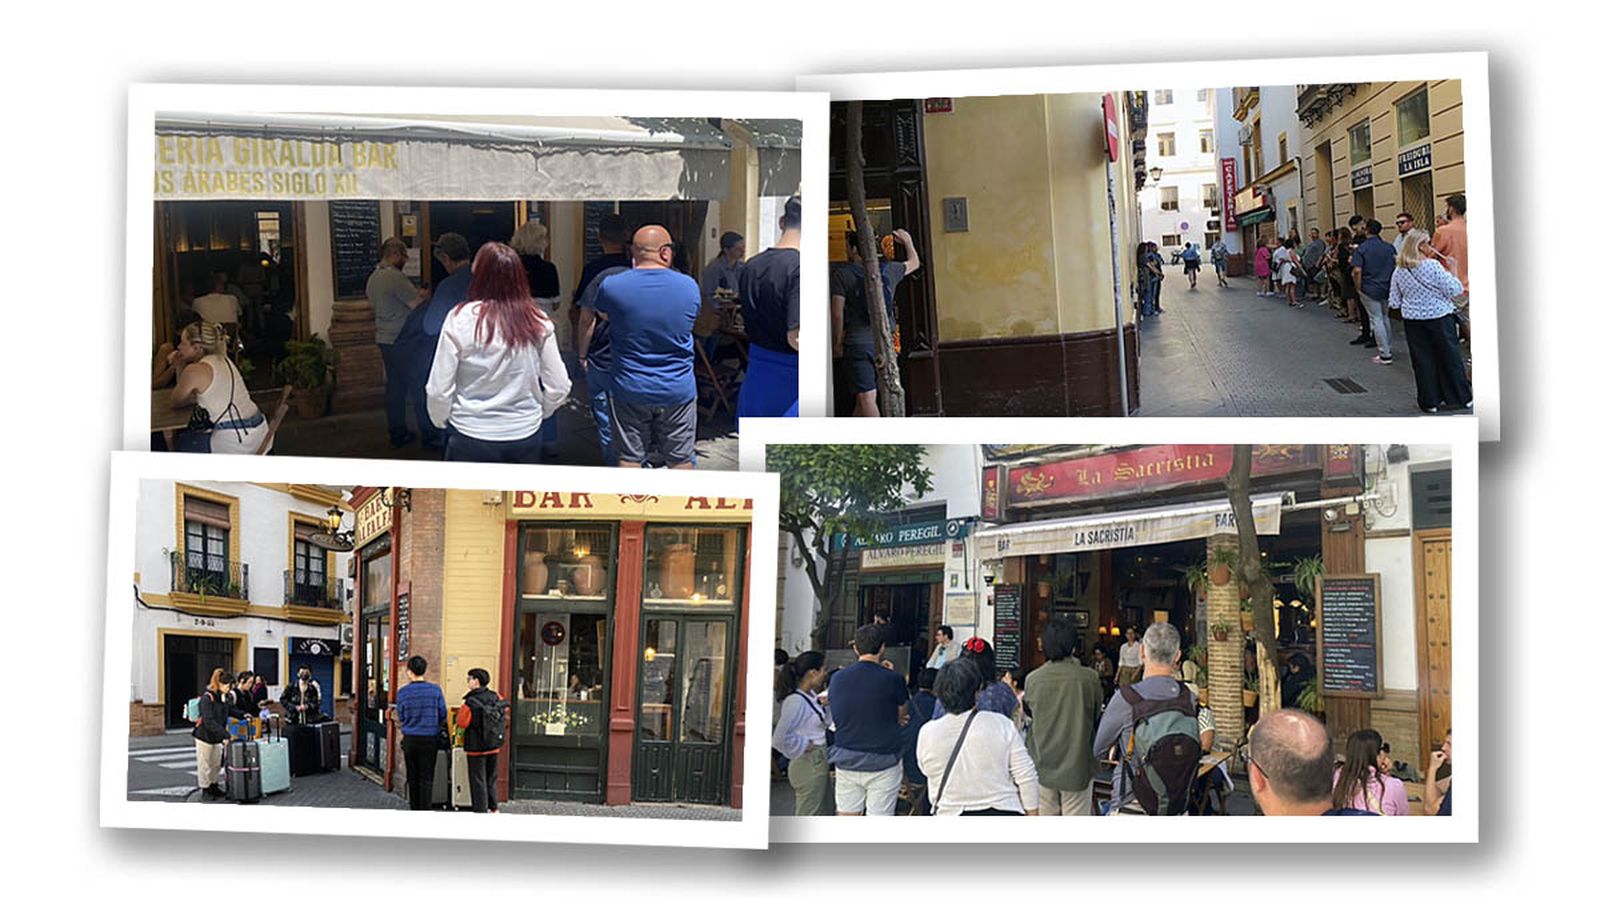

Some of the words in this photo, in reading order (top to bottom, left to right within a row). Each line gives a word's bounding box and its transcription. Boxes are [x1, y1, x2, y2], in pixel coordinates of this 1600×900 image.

[155, 136, 224, 165] ERIA
[233, 137, 343, 169] GIRALDA
[353, 142, 398, 170] BAR
[1413, 156, 1430, 170] ISLA
[273, 171, 328, 194] SIGLO
[334, 172, 358, 194] XII
[1077, 468, 1102, 486] La
[365, 497, 383, 521] BAR
[899, 526, 942, 542] PEREGIL
[1075, 532, 1086, 546] LA
[1087, 527, 1135, 545] SACRISTIA
